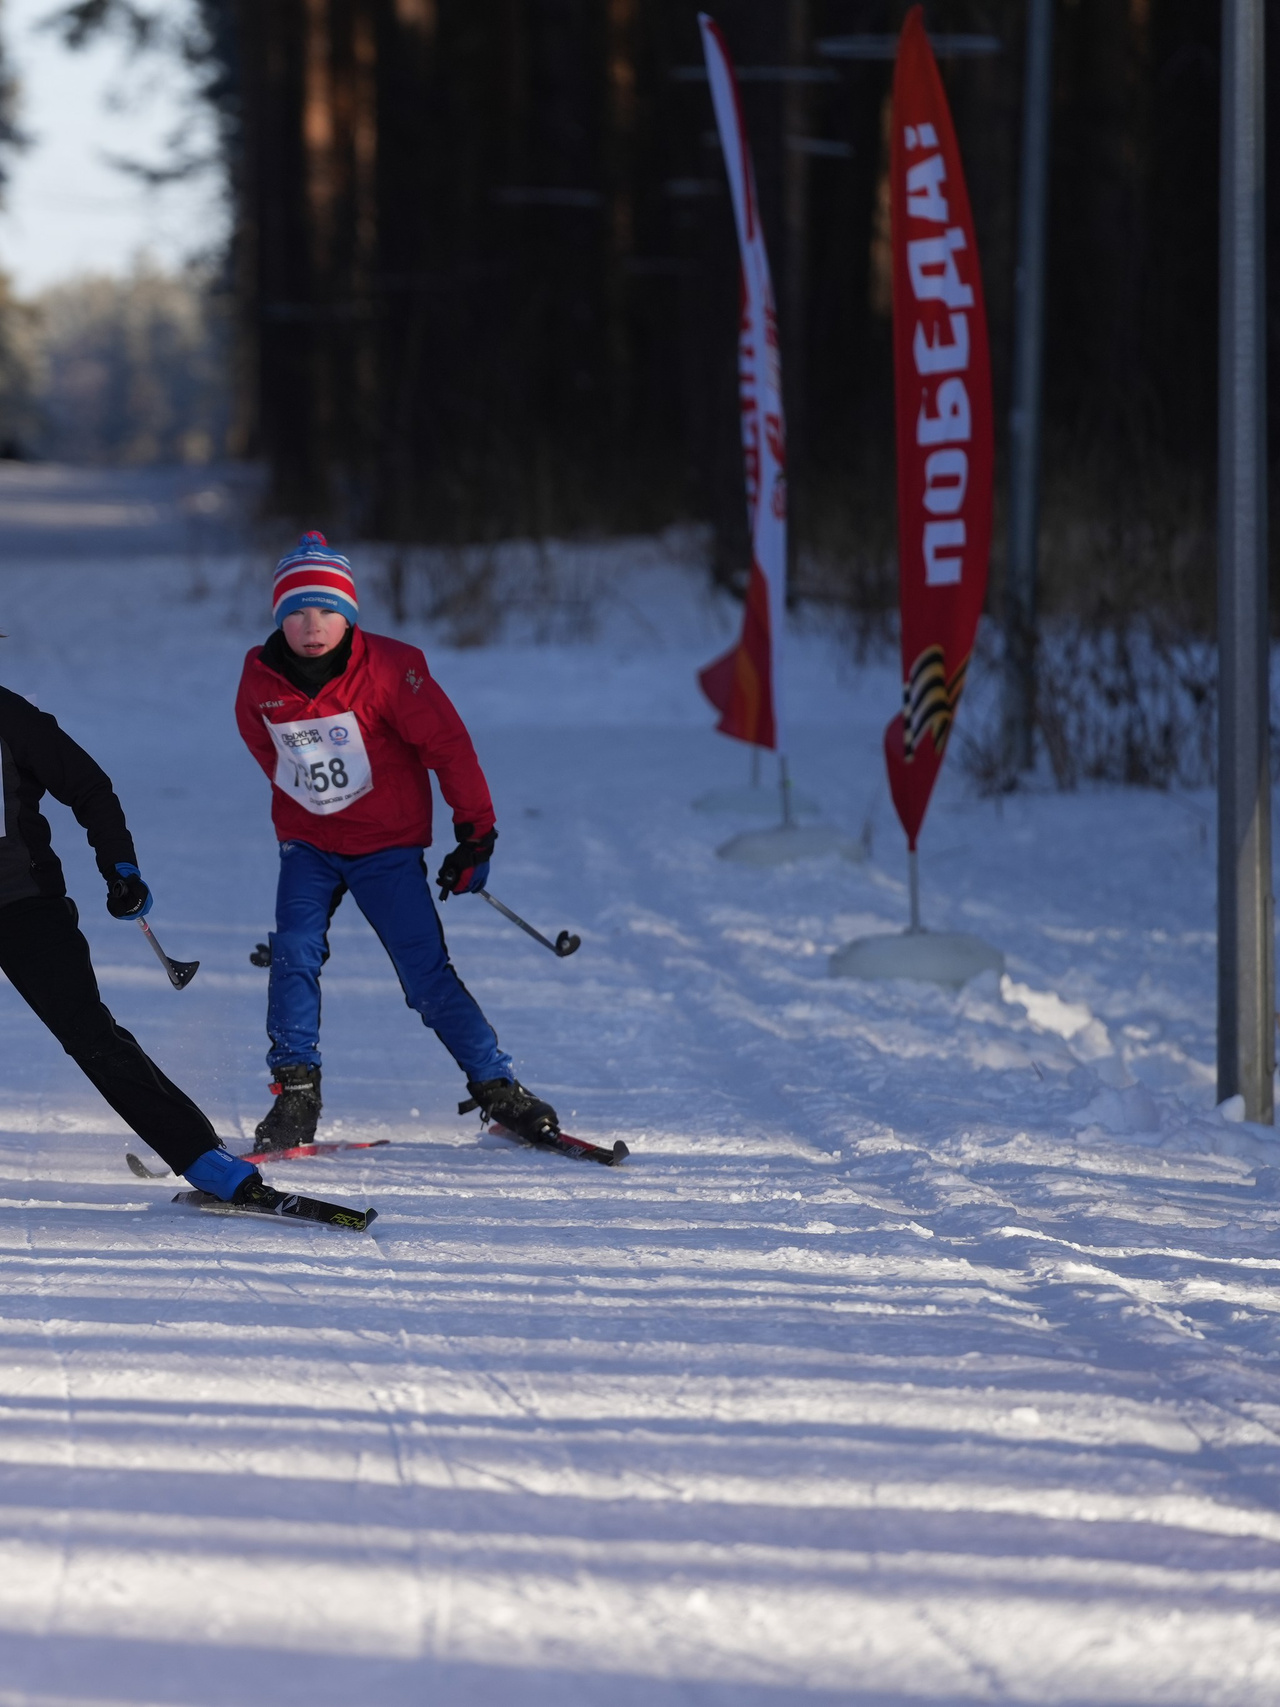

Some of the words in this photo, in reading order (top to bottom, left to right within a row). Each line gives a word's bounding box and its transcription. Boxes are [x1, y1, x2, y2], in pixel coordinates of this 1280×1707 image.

[904, 121, 974, 587] ПОБЕДА!
[301, 596, 338, 606] NORDSKI
[281, 729, 320, 743] ЛЫЖНЯ
